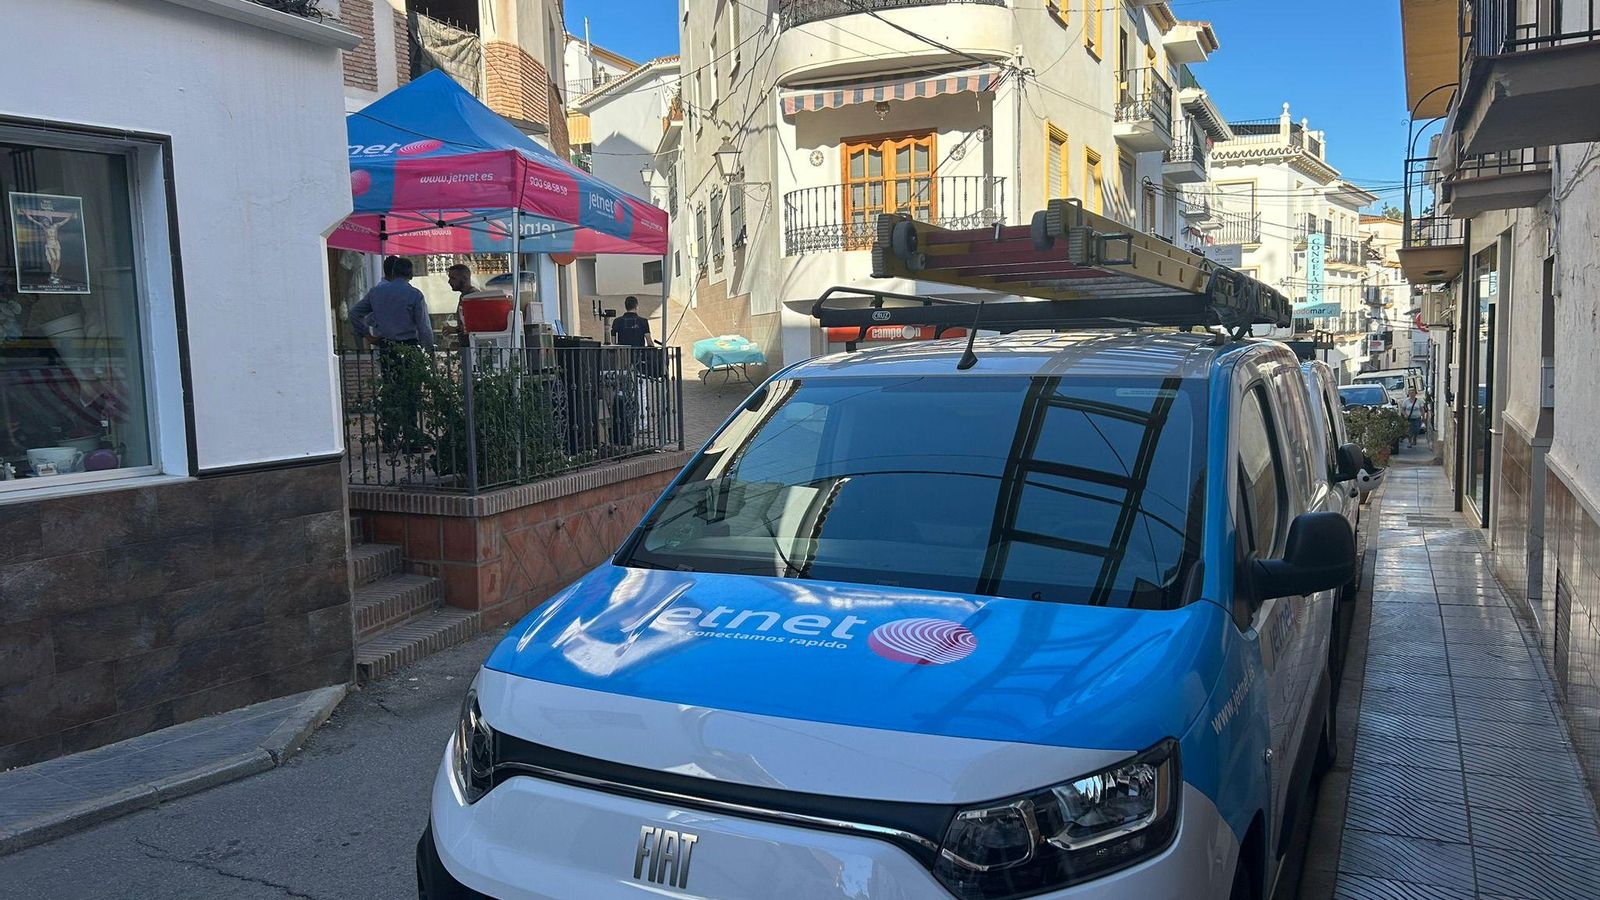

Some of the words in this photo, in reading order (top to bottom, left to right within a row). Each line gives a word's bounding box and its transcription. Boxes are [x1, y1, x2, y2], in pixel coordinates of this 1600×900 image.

[420, 172, 494, 184] www.jetnet.es
[588, 191, 614, 213] jetnet
[686, 629, 785, 643] conectamos
[790, 639, 848, 649] rapido
[633, 825, 699, 889] FIAT
